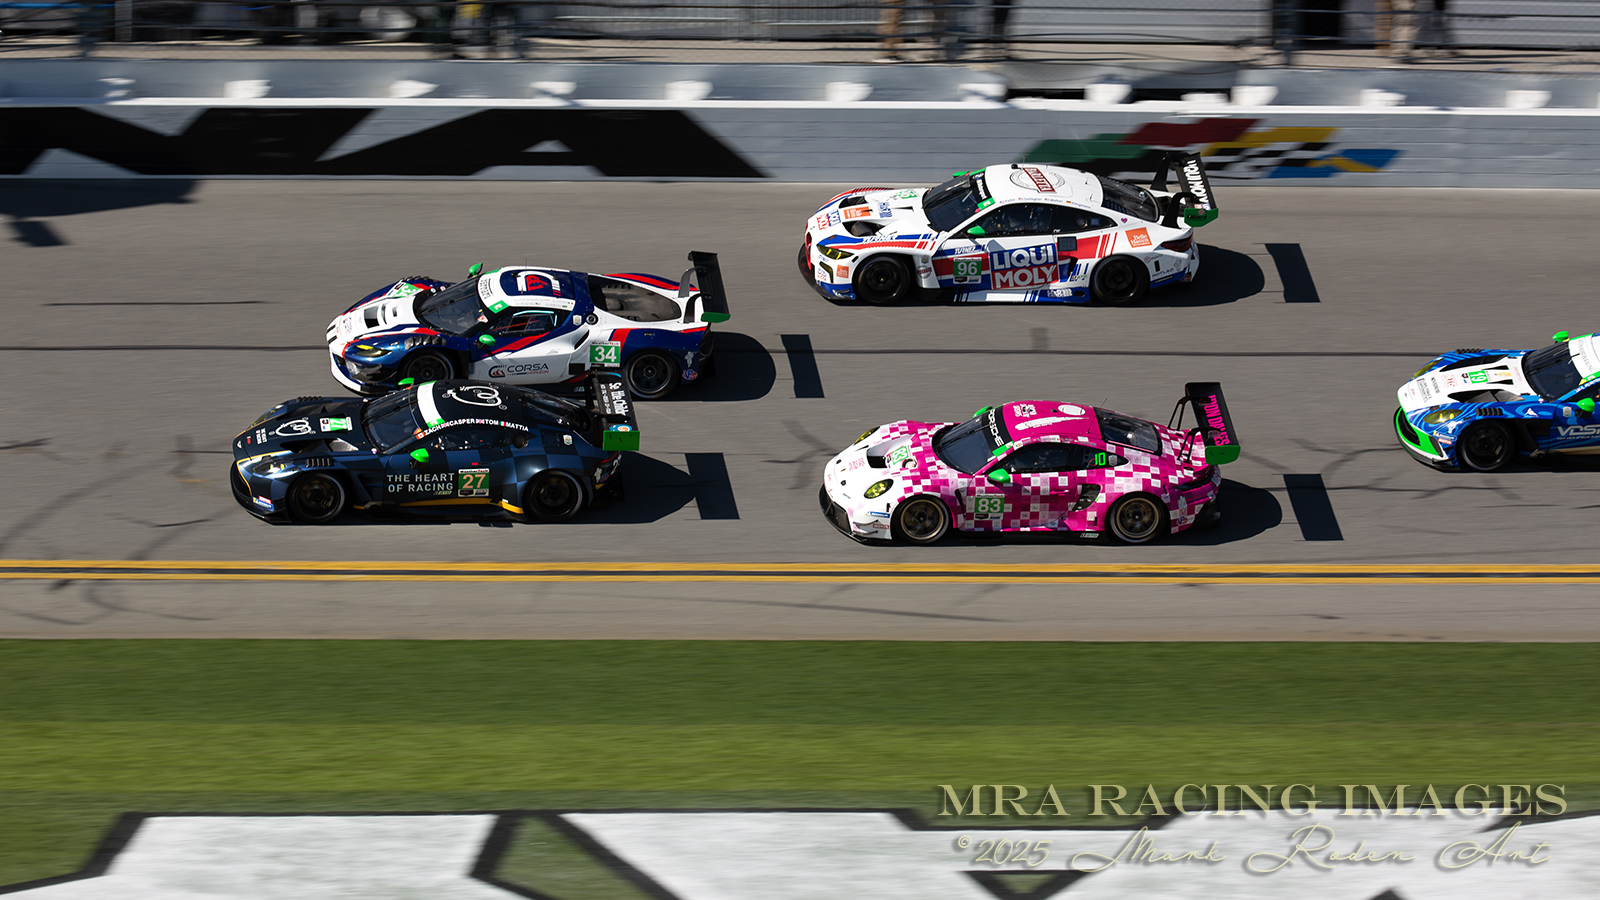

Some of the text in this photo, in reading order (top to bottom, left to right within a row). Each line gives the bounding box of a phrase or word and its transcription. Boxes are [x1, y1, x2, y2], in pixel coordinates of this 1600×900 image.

[993, 245, 1054, 269] LIQUI
[957, 262, 978, 275] 96
[995, 265, 1056, 288] MOLY
[594, 346, 617, 362] 34
[507, 363, 549, 372] CORSA
[424, 424, 442, 435] ZACH
[449, 418, 475, 426] CASPER
[506, 422, 529, 431] MATTIA
[988, 409, 1005, 447] PORSCHE
[1557, 424, 1600, 437] VDS
[1095, 452, 1106, 466] 10
[387, 473, 455, 482] THE HEART
[462, 474, 486, 488] 27
[408, 483, 454, 492] RACING
[977, 499, 1001, 513] 83
